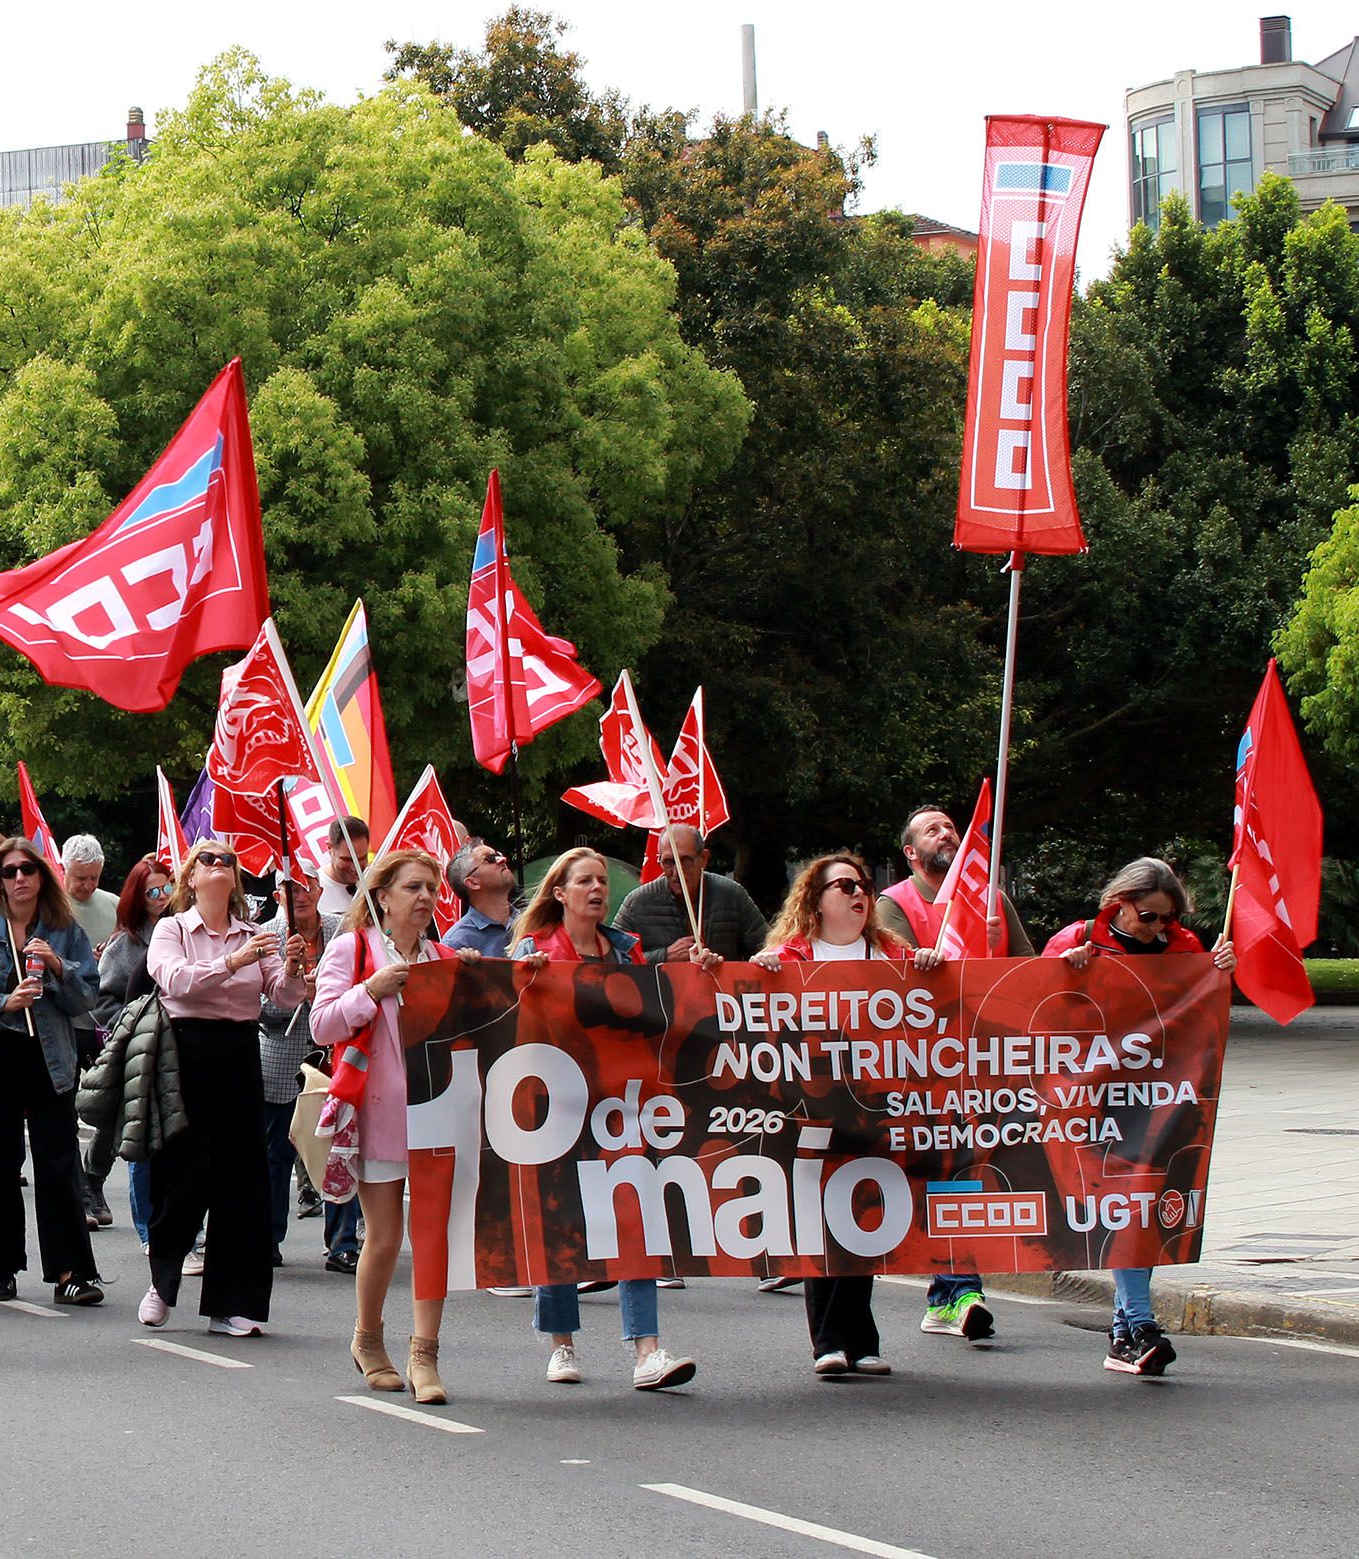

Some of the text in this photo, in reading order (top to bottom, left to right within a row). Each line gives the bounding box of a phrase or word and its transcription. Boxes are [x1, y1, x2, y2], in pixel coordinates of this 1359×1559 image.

[715, 988, 948, 1034] DEREITOS,
[712, 1032, 1164, 1083] NON TRINCHEIRAS.
[591, 1079, 685, 1151] de
[886, 1080, 1199, 1117] SALARIOS, VIVENDA
[707, 1106, 786, 1134] 2026
[889, 1116, 1124, 1151] E DEMOCRACIA
[577, 1126, 913, 1261] maio
[935, 1201, 1038, 1228] CCOO
[1065, 1191, 1156, 1233] UGT
